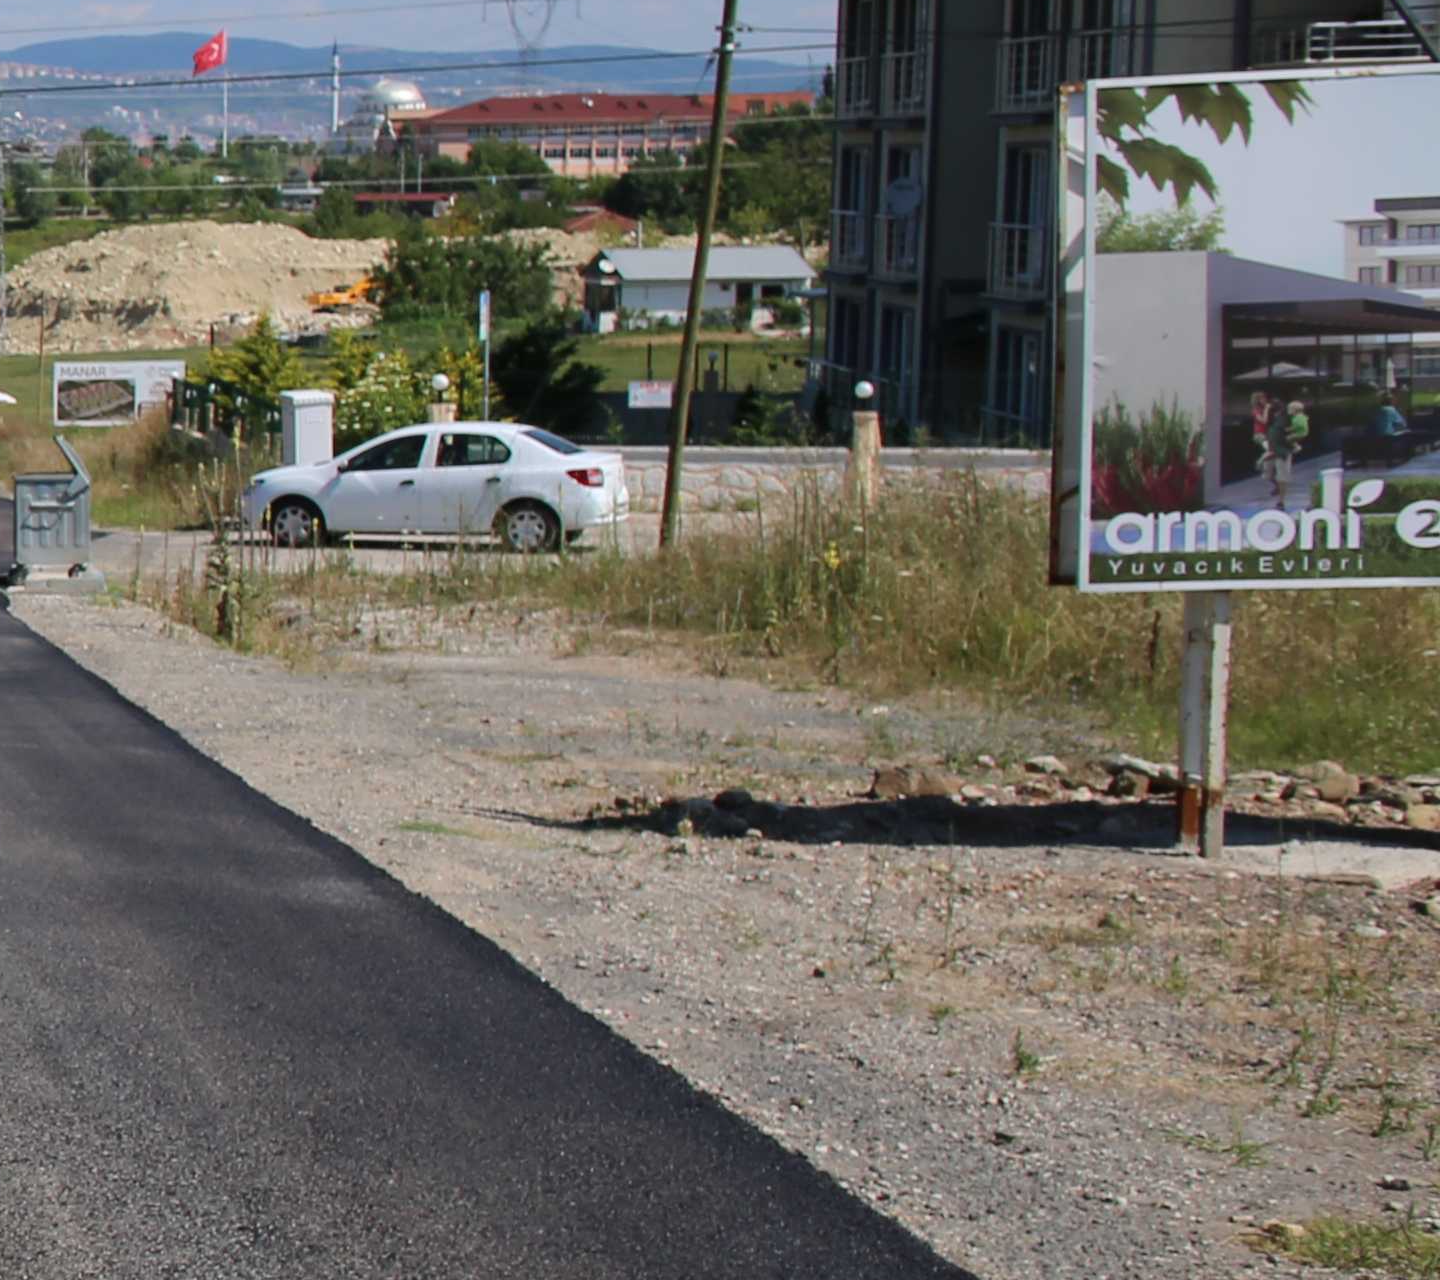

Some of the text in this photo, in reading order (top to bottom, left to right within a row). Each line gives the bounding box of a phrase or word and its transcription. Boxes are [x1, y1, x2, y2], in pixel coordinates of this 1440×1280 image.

[1105, 478, 1384, 554] armoni
[1109, 554, 1364, 575] Yuvacık Evleri
